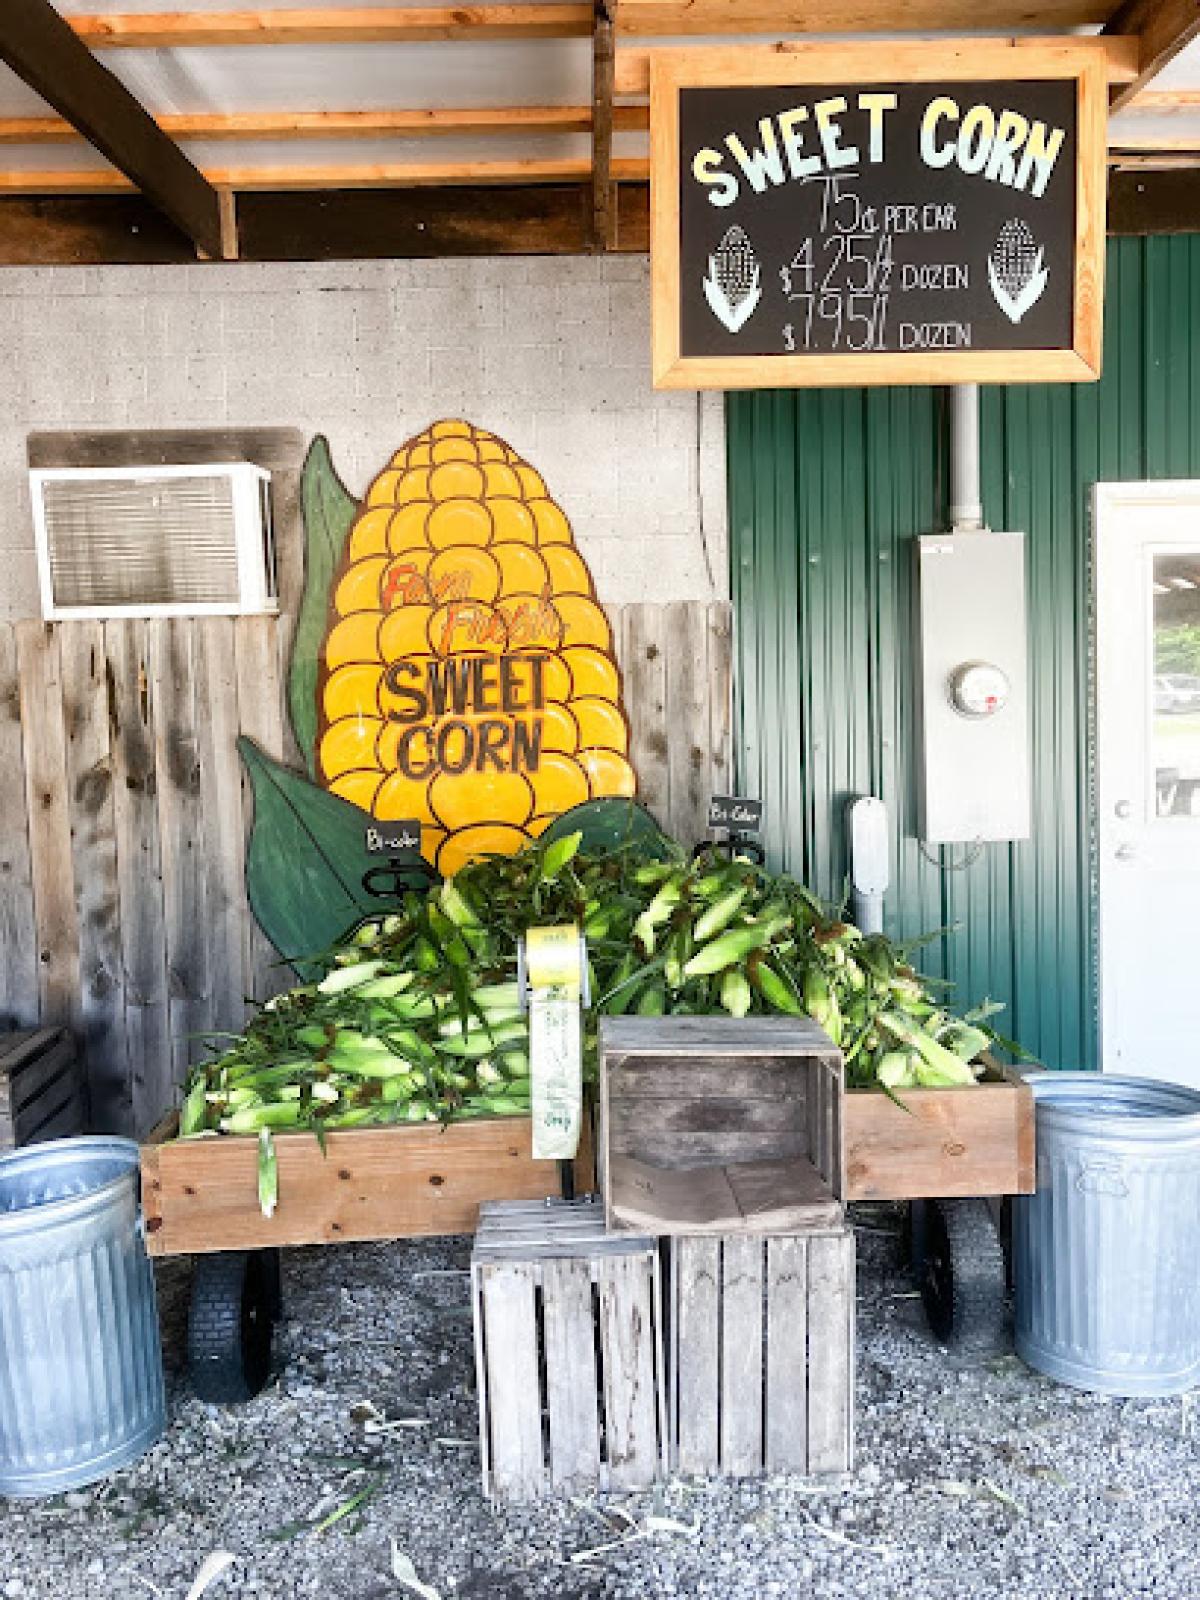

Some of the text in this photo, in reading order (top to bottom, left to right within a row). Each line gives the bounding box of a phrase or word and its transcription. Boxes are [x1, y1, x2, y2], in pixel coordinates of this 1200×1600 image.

[692, 93, 1066, 206] SWEET CORN
[885, 205, 918, 232] PER
[923, 203, 957, 231] EAR
[902, 264, 969, 291] DOZEN
[900, 322, 972, 349] DOZEN
[384, 655, 549, 723] SWEET
[397, 718, 542, 781] CORN
